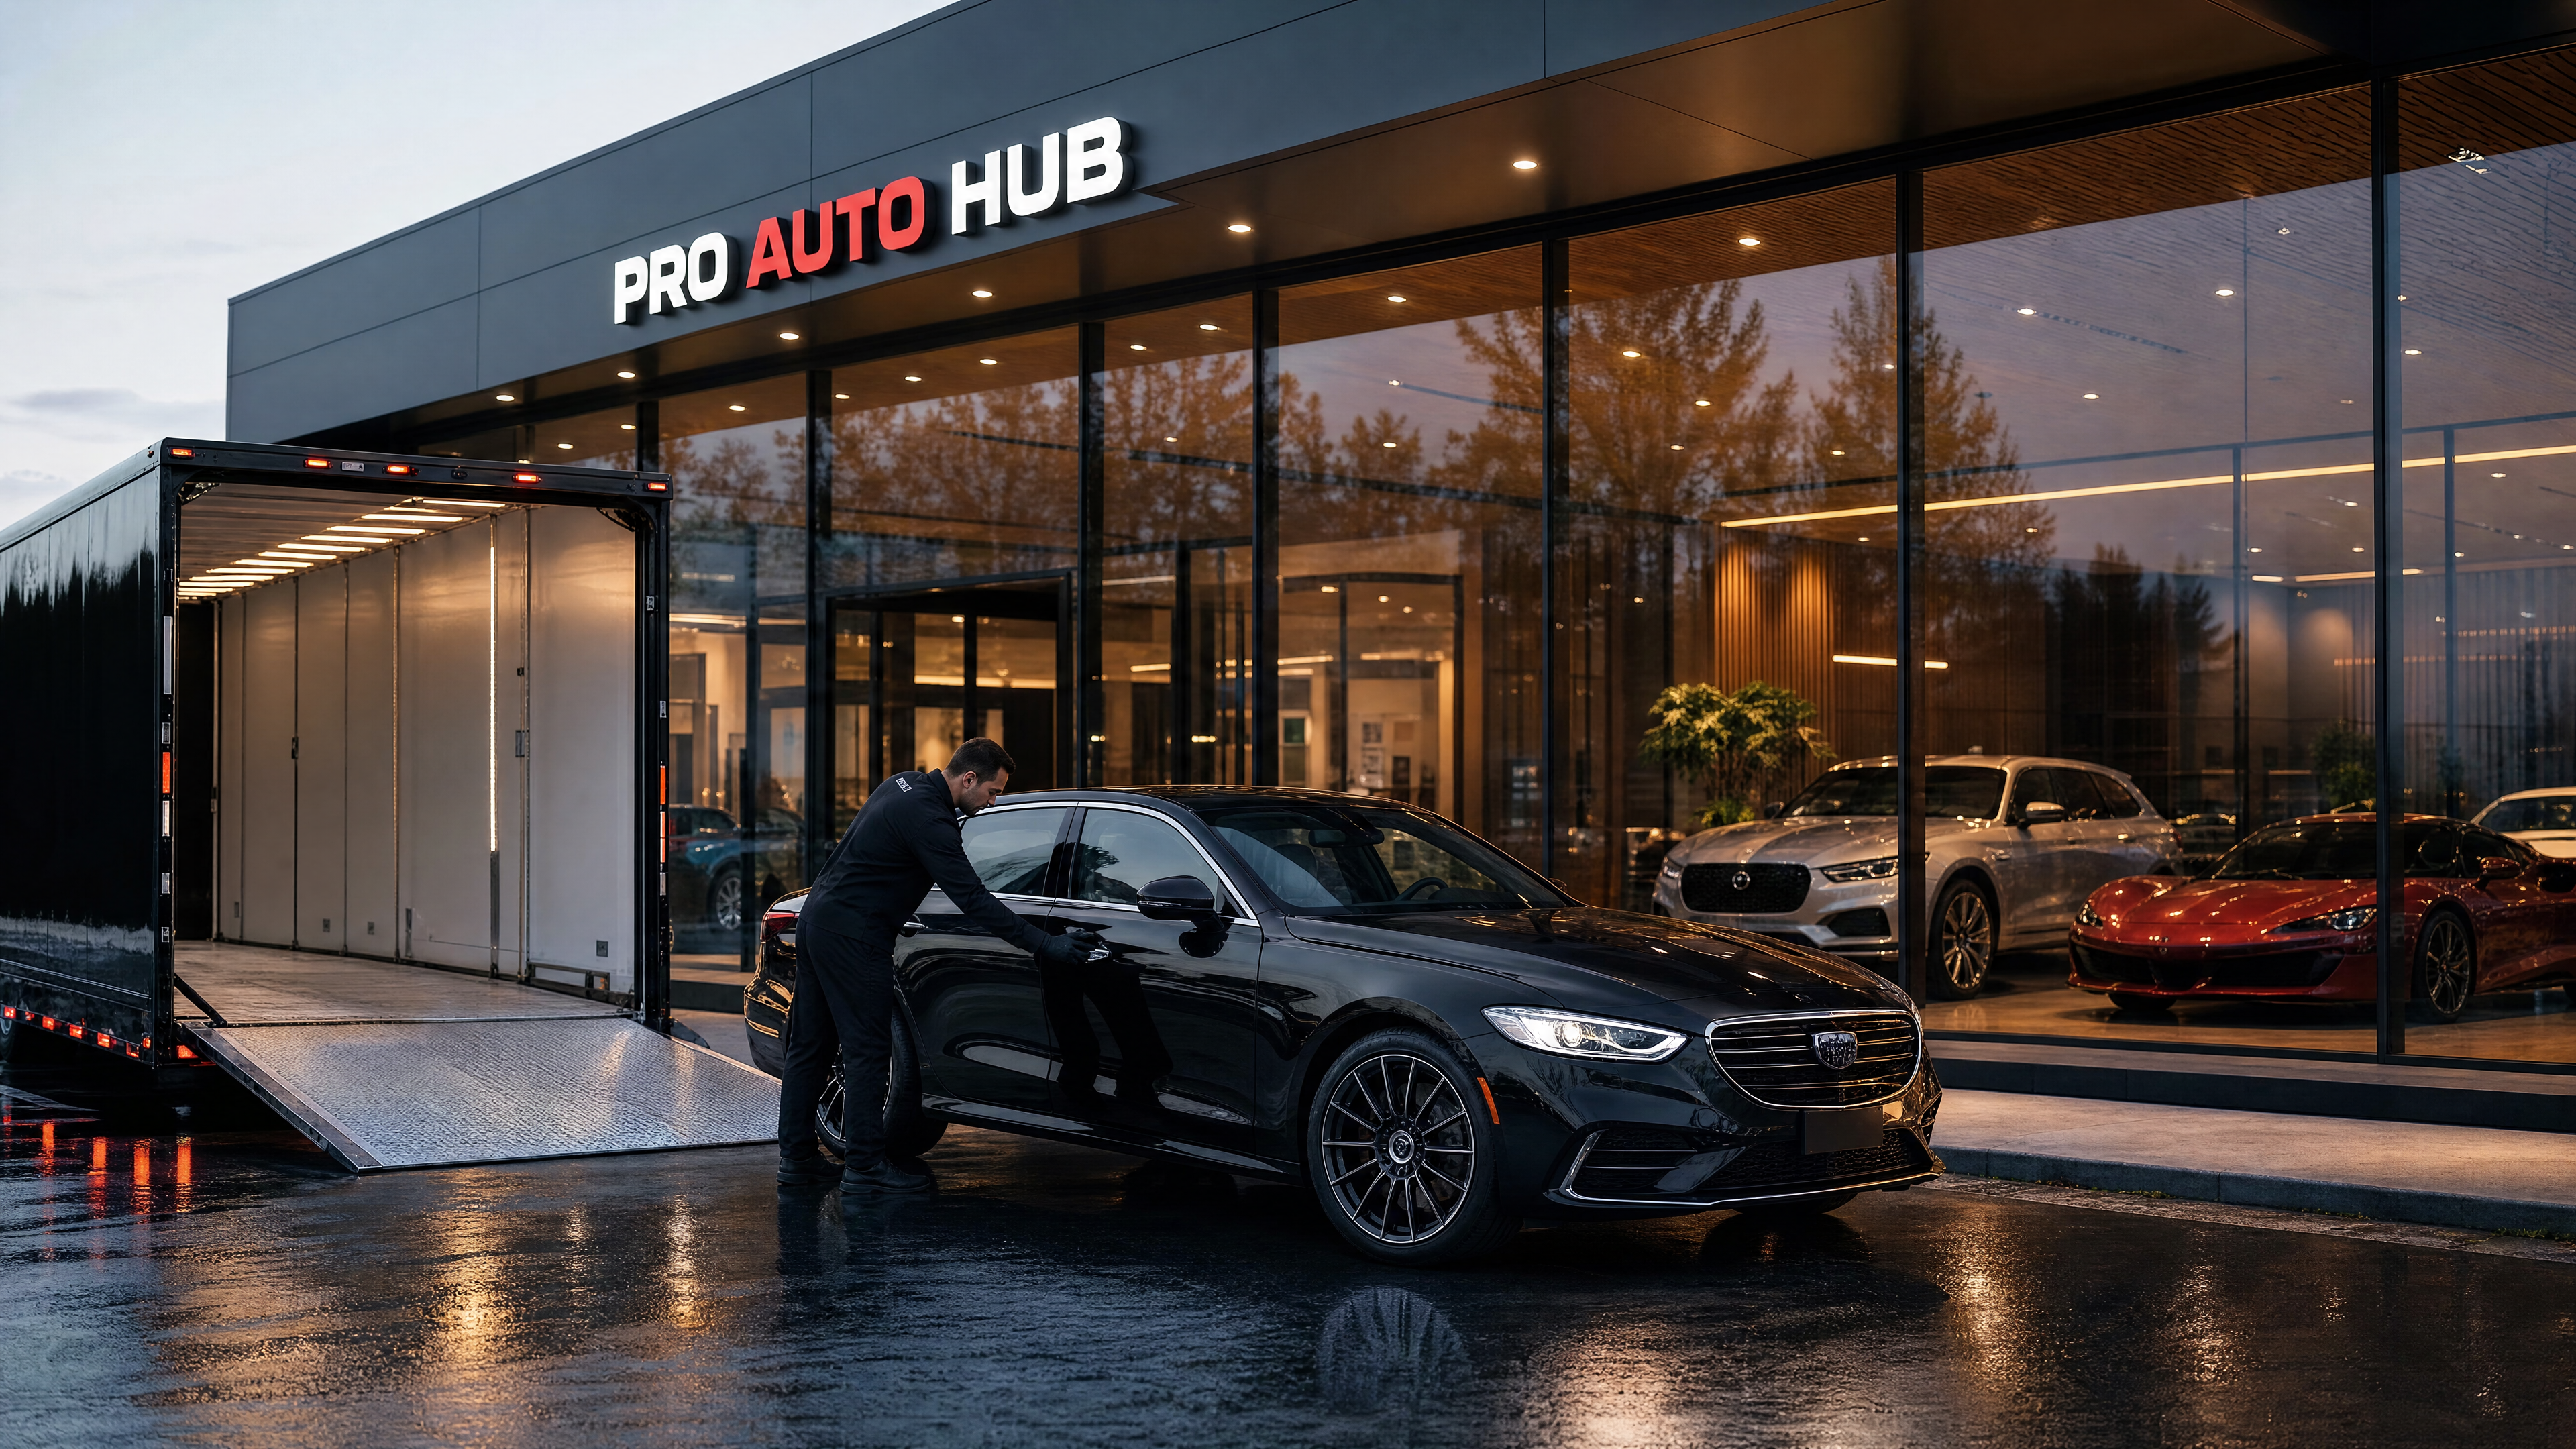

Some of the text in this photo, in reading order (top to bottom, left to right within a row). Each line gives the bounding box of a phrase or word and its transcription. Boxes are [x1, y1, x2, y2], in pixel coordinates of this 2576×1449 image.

[614, 116, 1124, 324] PRO AUTO HUB
